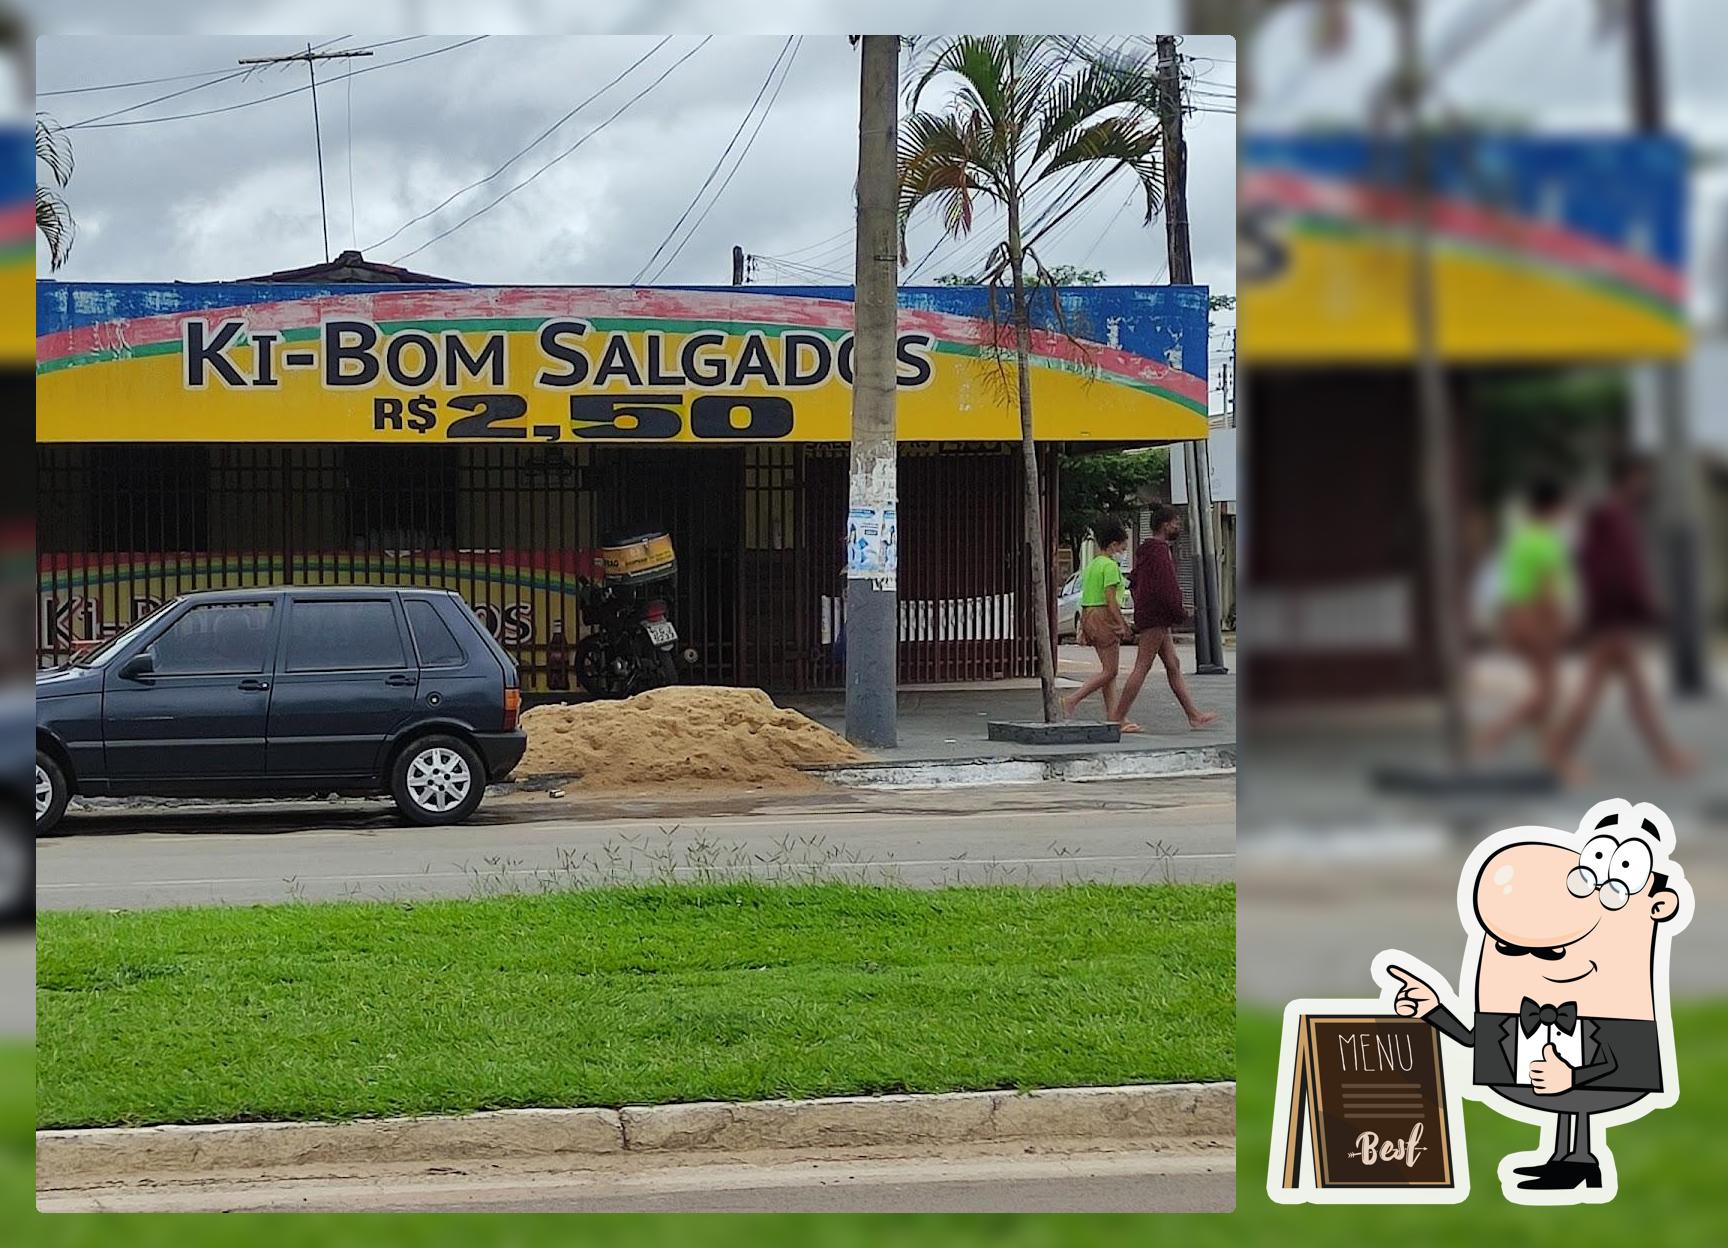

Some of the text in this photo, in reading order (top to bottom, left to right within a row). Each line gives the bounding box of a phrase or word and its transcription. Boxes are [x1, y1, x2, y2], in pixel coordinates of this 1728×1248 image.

[186, 321, 505, 387] KI-BOM
[374, 394, 794, 441] R$ 2,50
